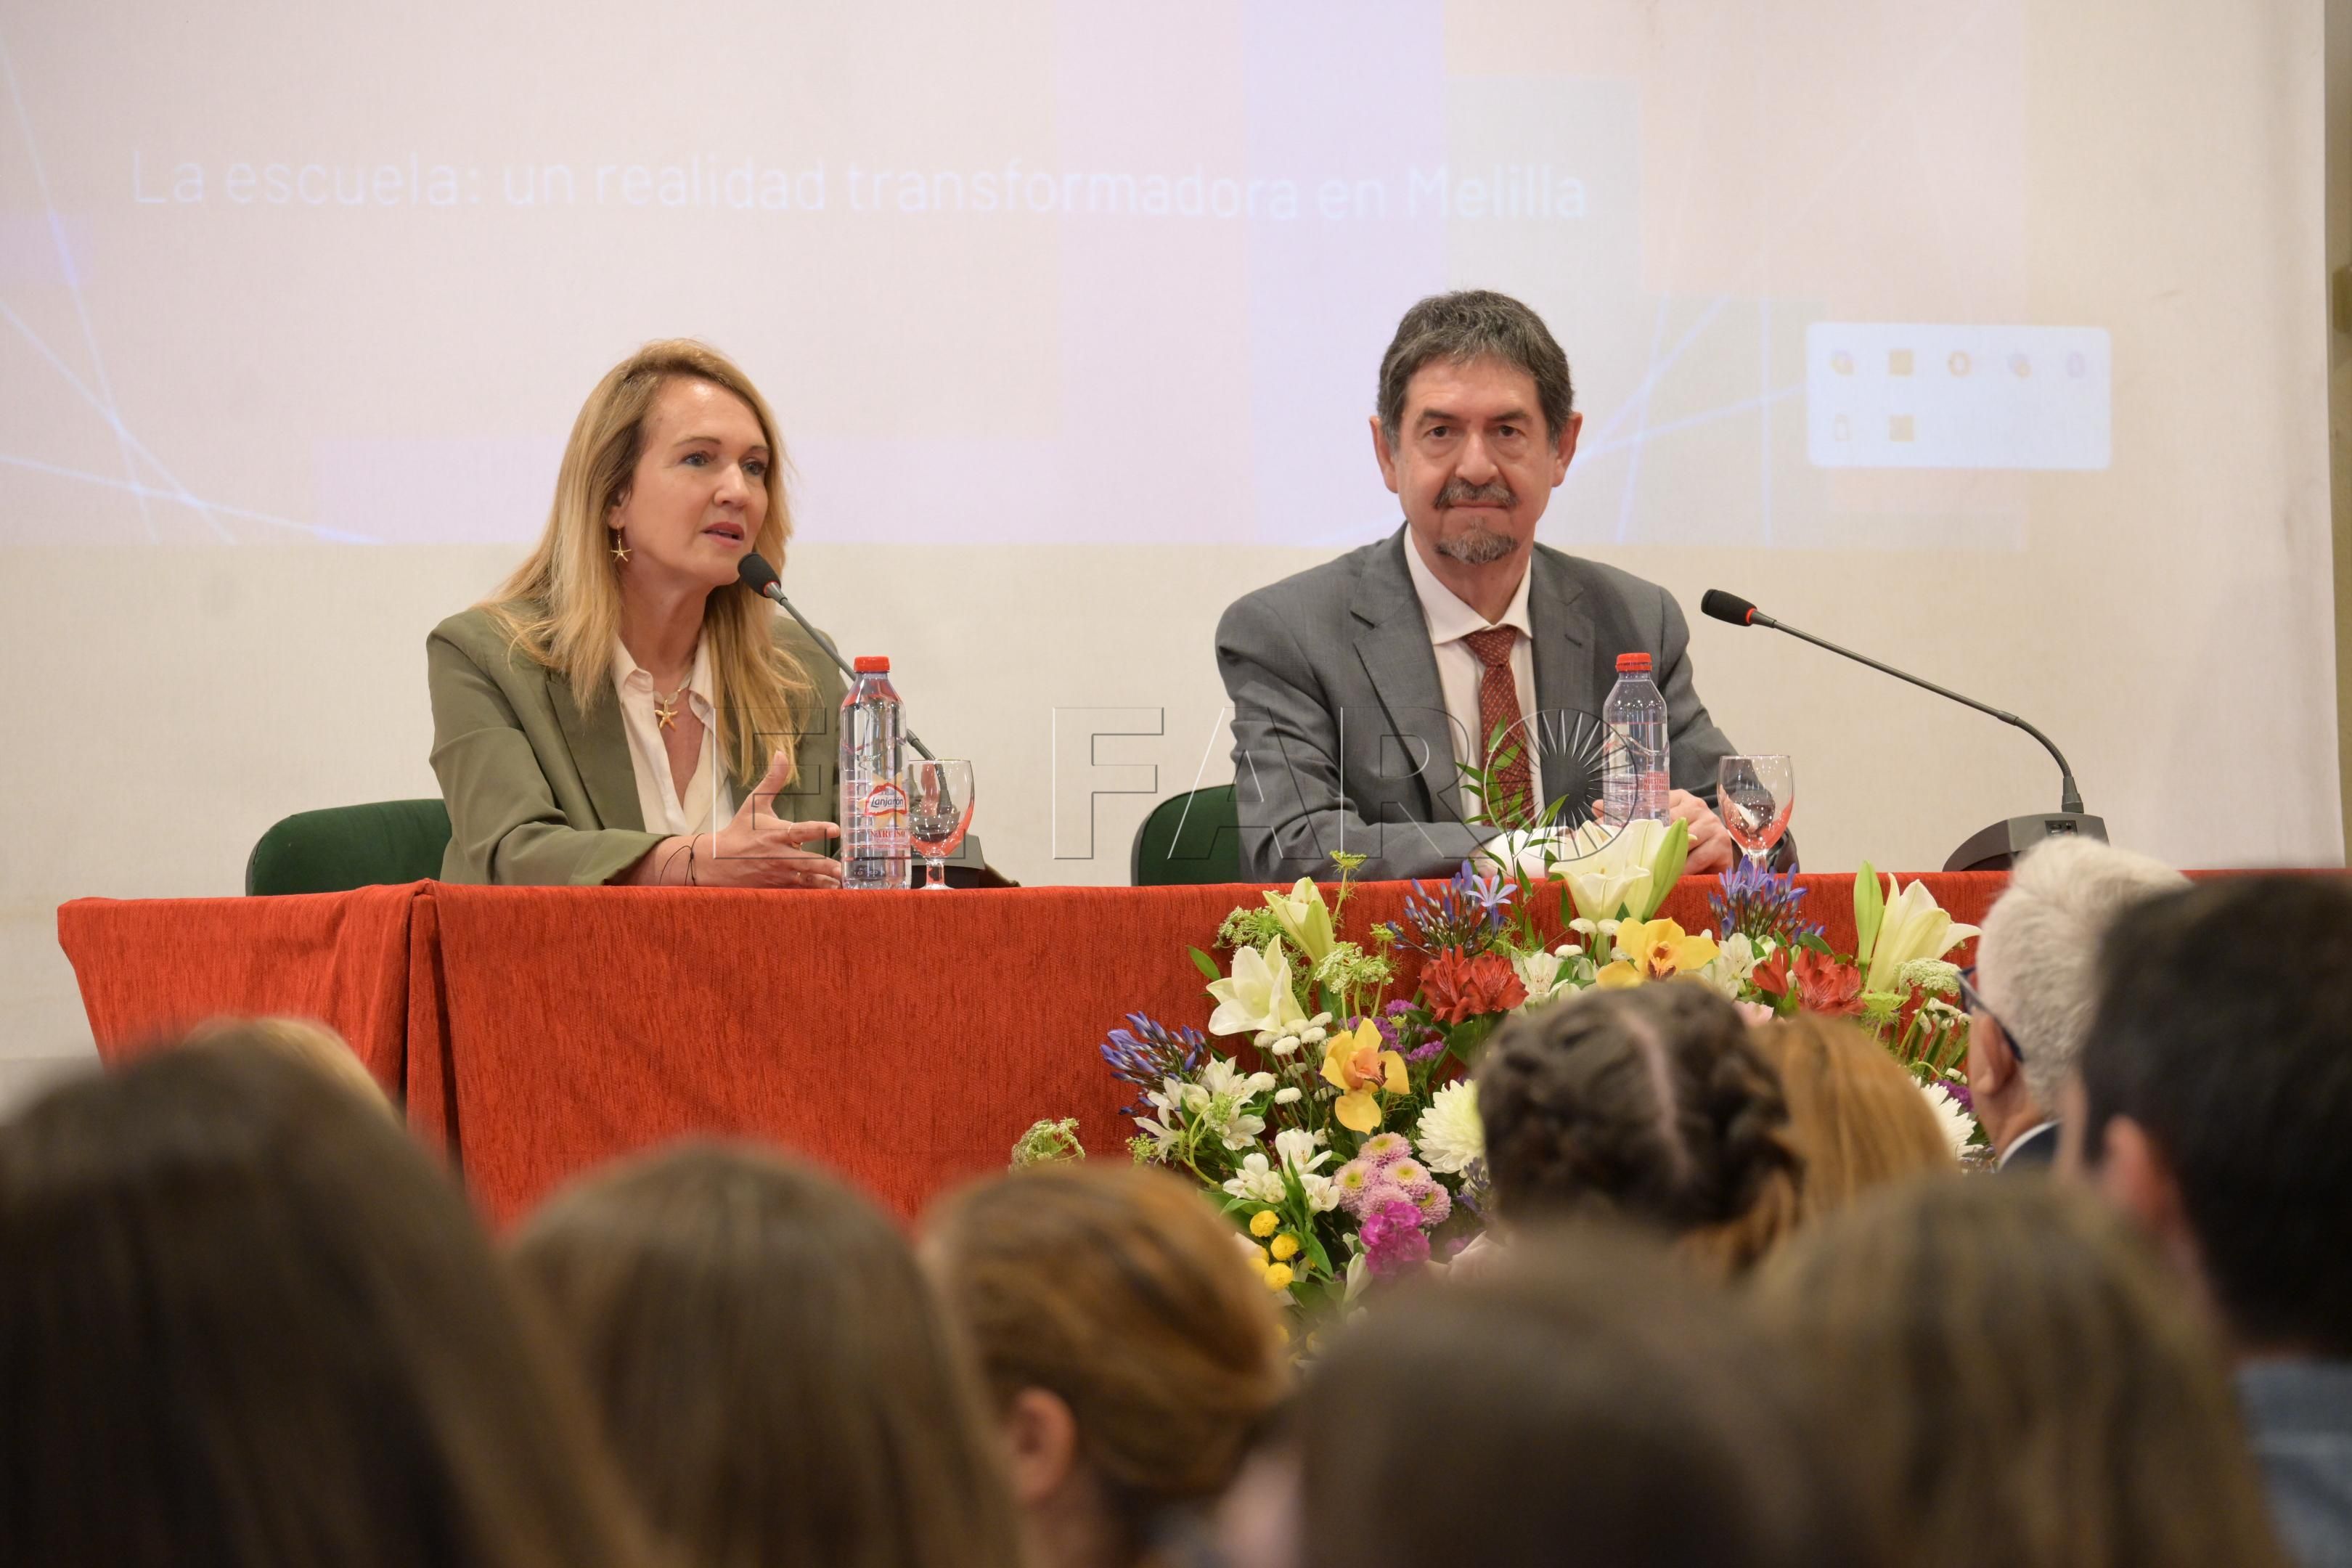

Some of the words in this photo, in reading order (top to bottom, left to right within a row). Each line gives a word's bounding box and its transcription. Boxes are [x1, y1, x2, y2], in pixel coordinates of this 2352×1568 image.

[133, 150, 206, 204] La
[225, 151, 481, 206] escuela:
[505, 162, 575, 207] un
[597, 154, 826, 211] realidad
[846, 157, 1298, 219] transformadora
[1318, 176, 1384, 221] en
[1407, 163, 1588, 220] Melilla
[871, 796, 904, 808] Lanjarón
